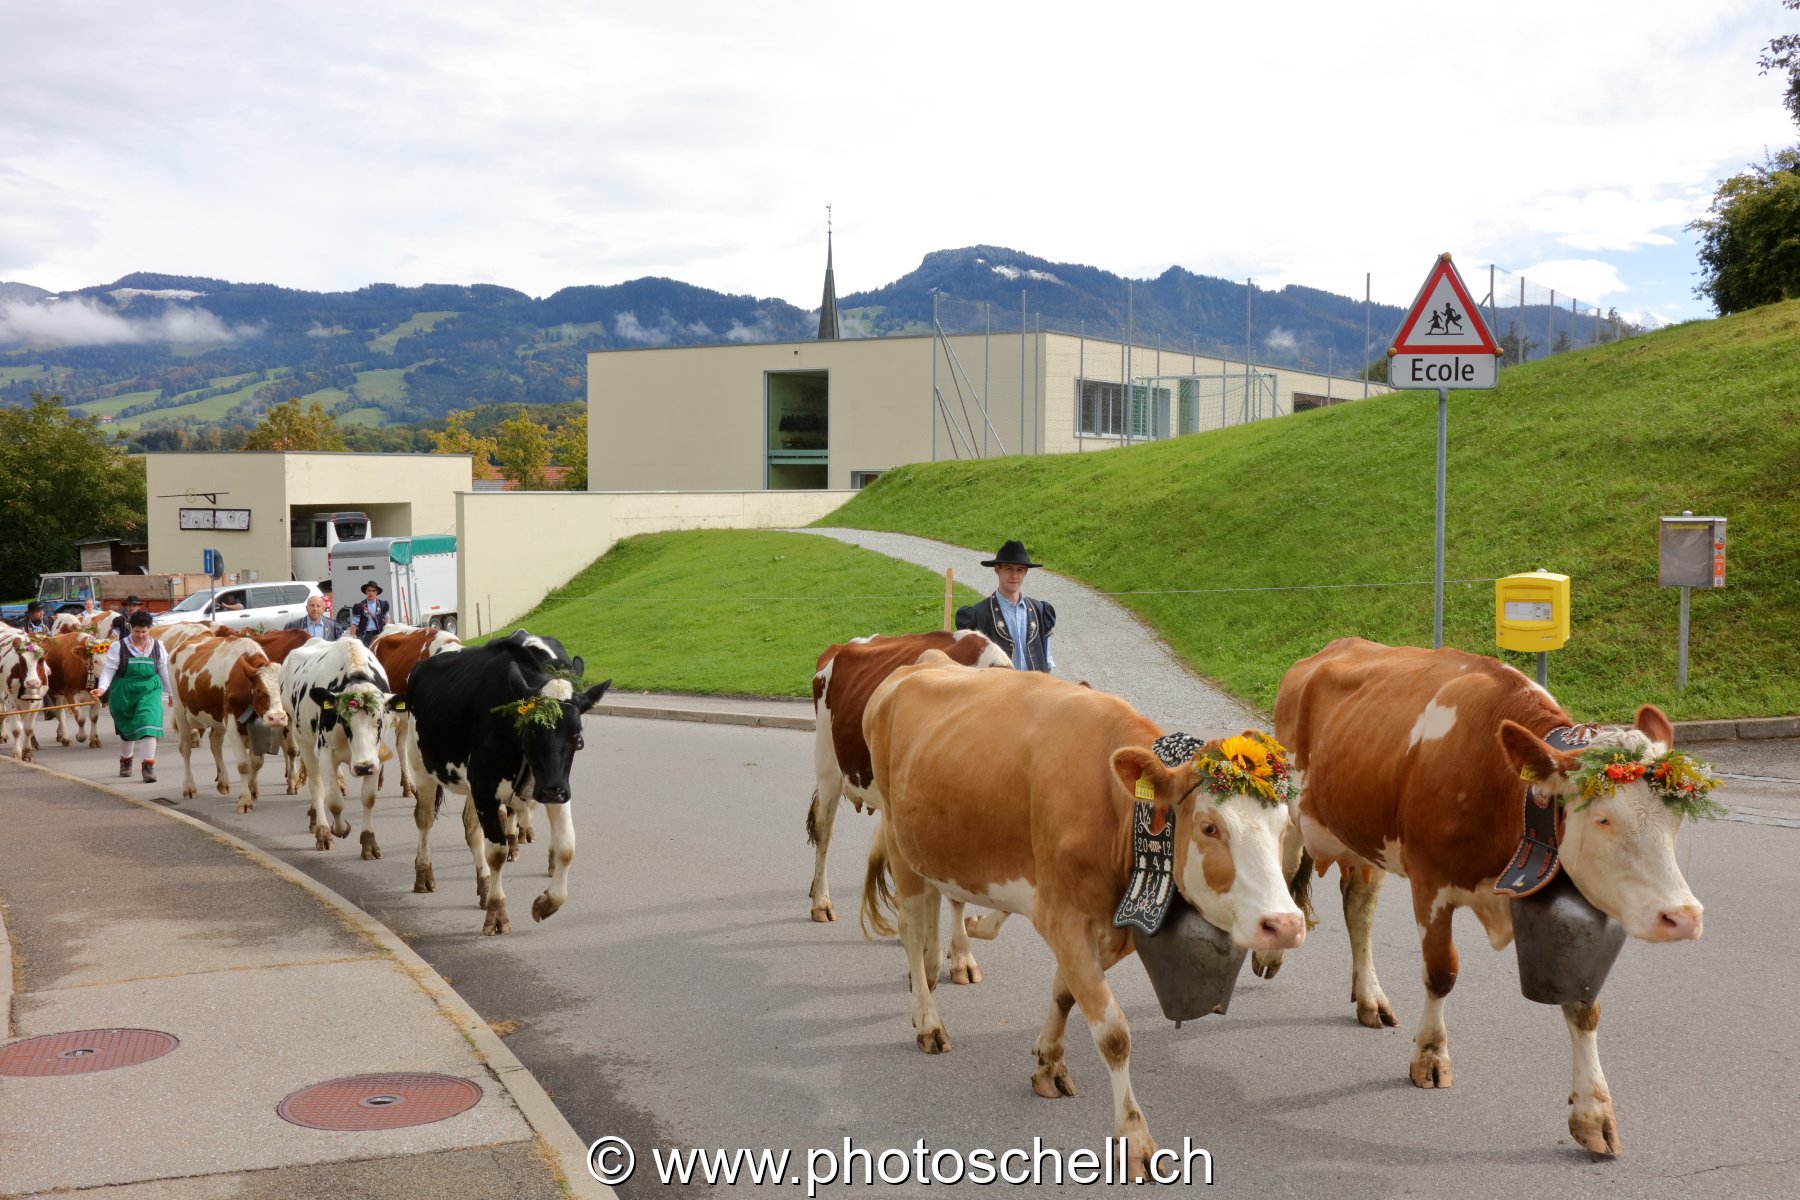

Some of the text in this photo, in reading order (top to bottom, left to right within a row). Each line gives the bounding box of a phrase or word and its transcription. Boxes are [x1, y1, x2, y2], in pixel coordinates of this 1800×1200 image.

[1412, 357, 1474, 381] Ecole
[1137, 837, 1172, 856] 20 12
